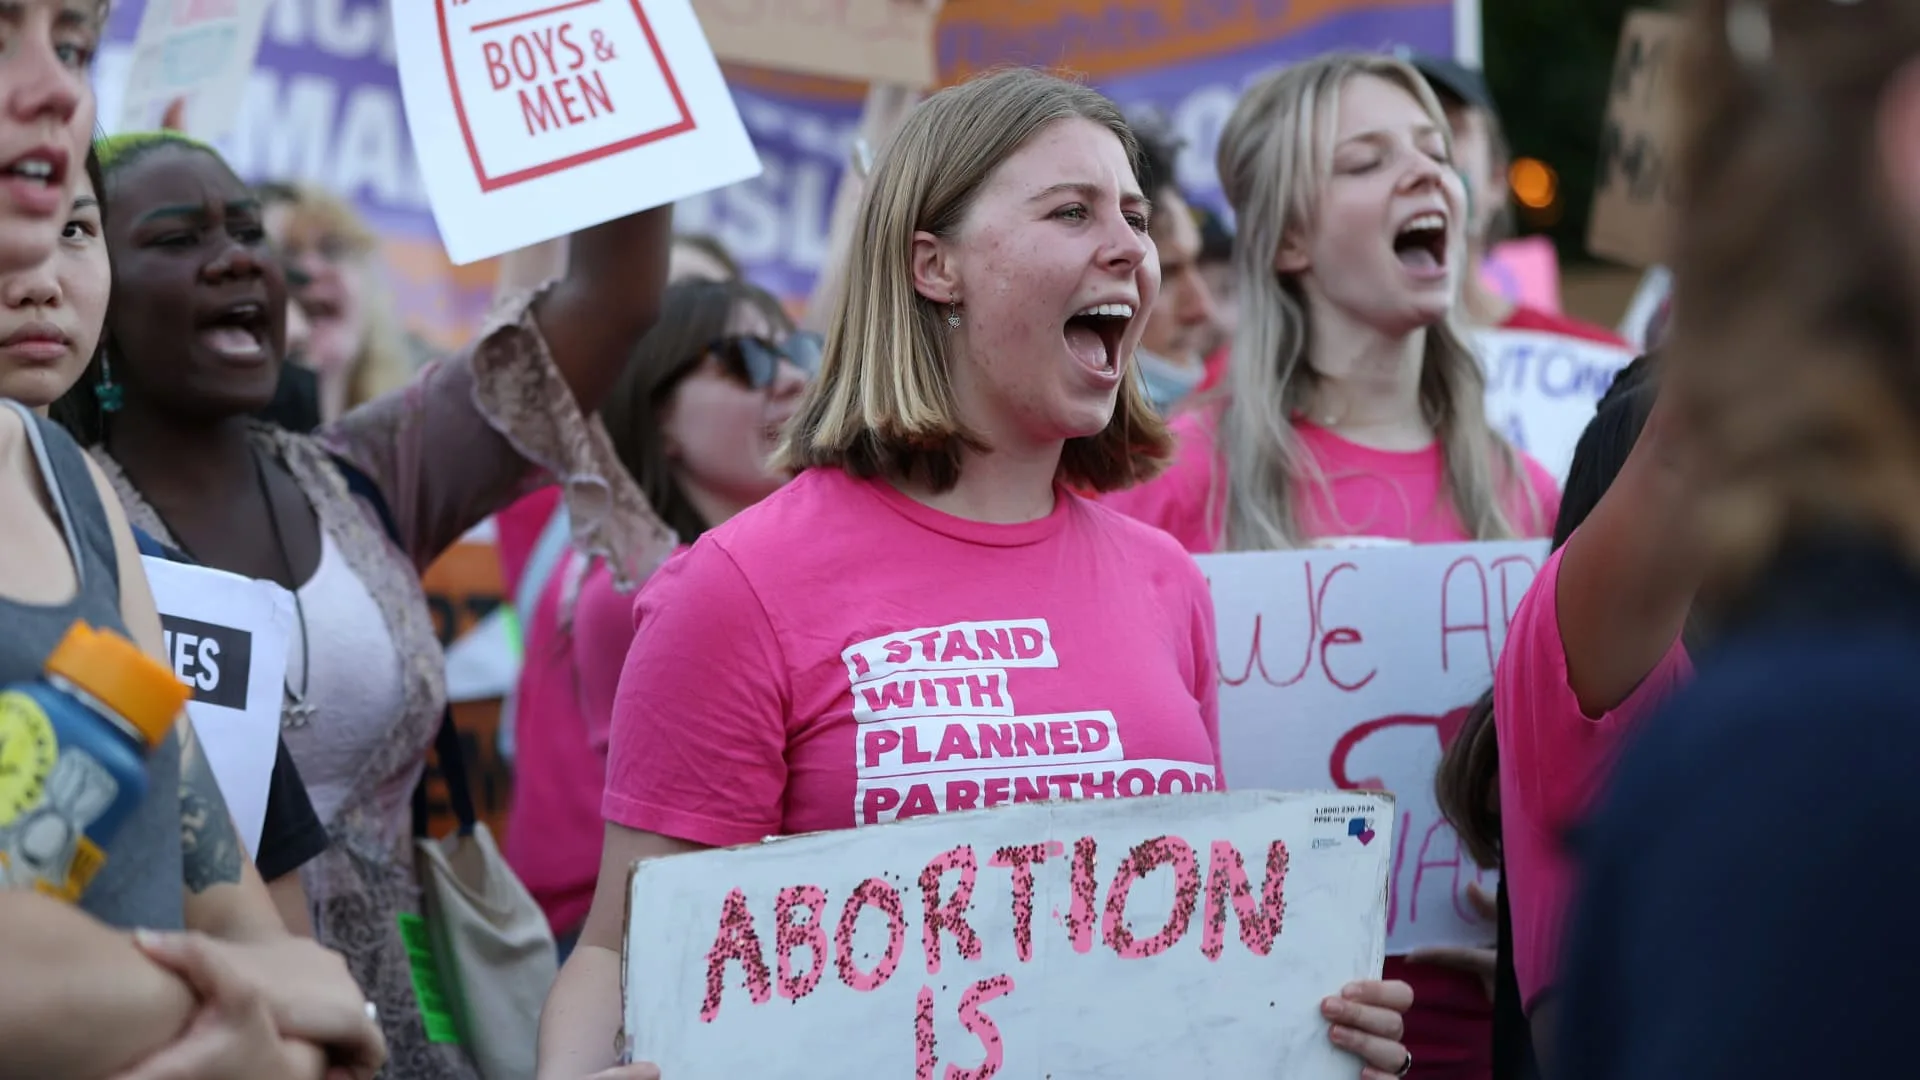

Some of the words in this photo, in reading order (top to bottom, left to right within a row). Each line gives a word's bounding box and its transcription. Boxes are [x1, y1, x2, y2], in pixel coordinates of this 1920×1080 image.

[482, 22, 585, 91] BOYS
[589, 29, 619, 62] &
[517, 69, 615, 136] MEN
[882, 627, 1045, 664] STAND
[860, 673, 1005, 713] WITH
[863, 719, 1111, 768] PLANNED
[862, 767, 1214, 825] PARENTHOOD
[698, 834, 1290, 1023] ABORTION
[914, 973, 1016, 1080] IS
